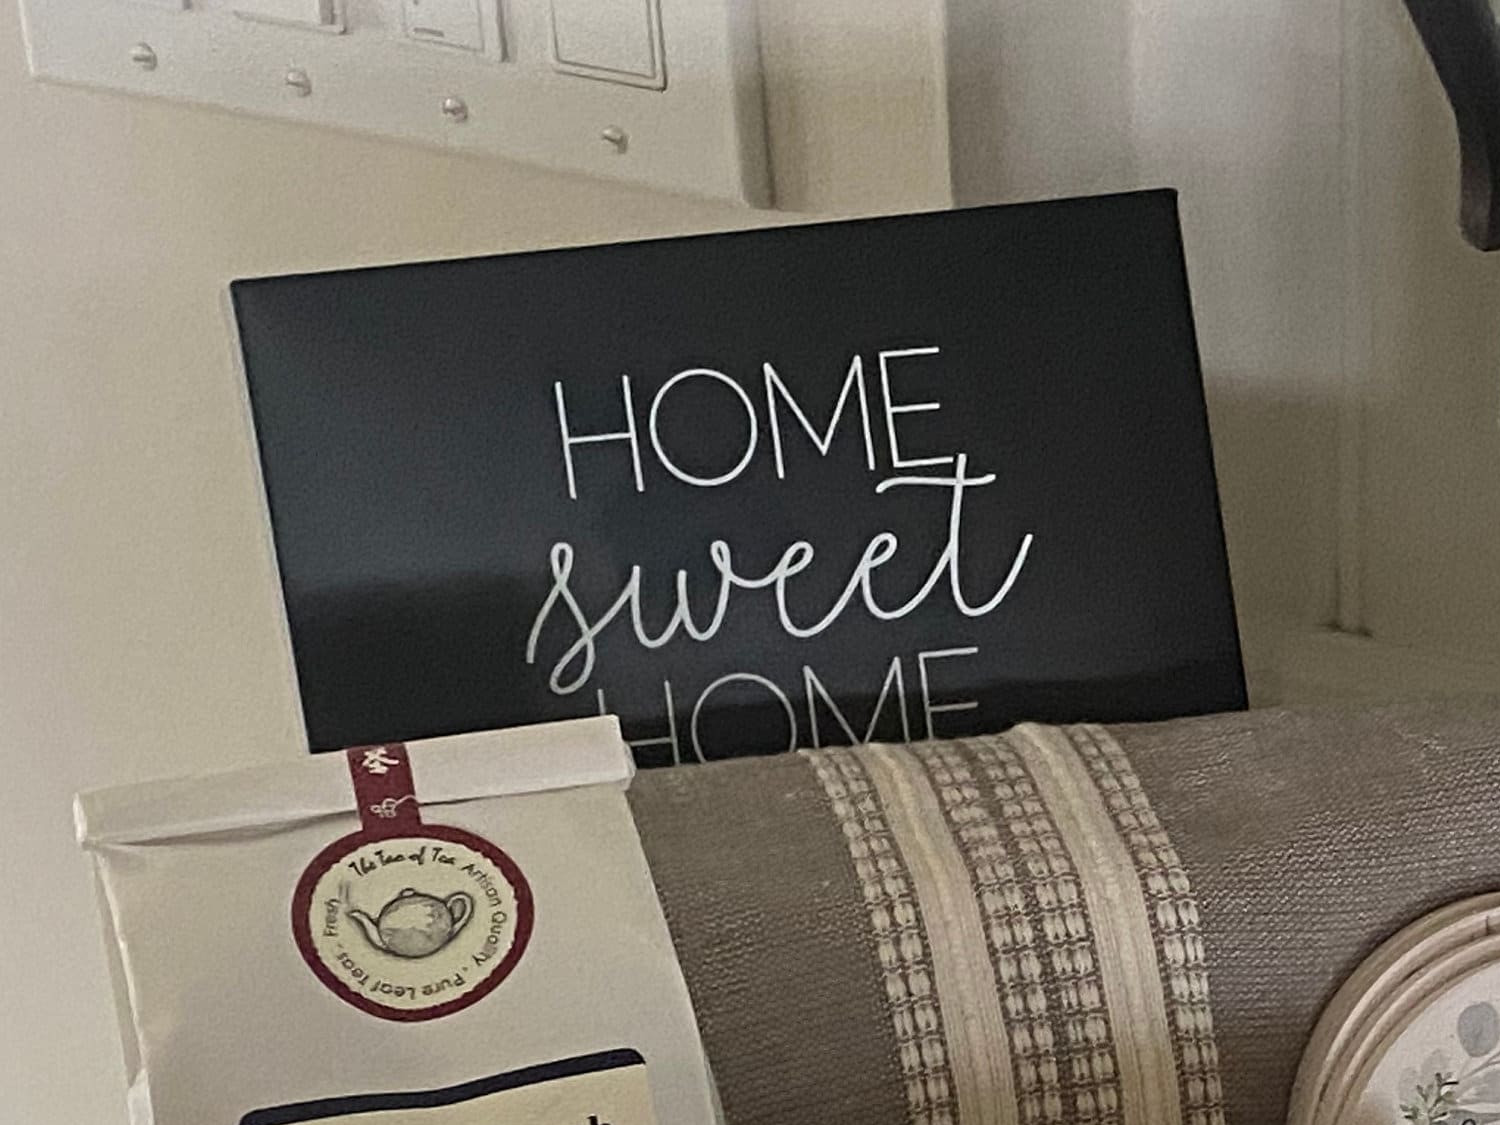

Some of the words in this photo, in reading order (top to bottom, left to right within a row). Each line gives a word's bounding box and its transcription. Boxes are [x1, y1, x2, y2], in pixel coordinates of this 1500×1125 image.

[555, 346, 953, 499] HOME
[526, 453, 1033, 695] sweet
[597, 647, 979, 766] HOME
[348, 854, 377, 877] The
[406, 846, 426, 866] of
[431, 848, 457, 865] Tea
[461, 863, 502, 907] Artisan
[323, 898, 342, 938] Fresh
[472, 910, 508, 967] Quality
[336, 951, 371, 987] Teas
[370, 980, 416, 1000] Leaf
[421, 972, 466, 997] Pure
